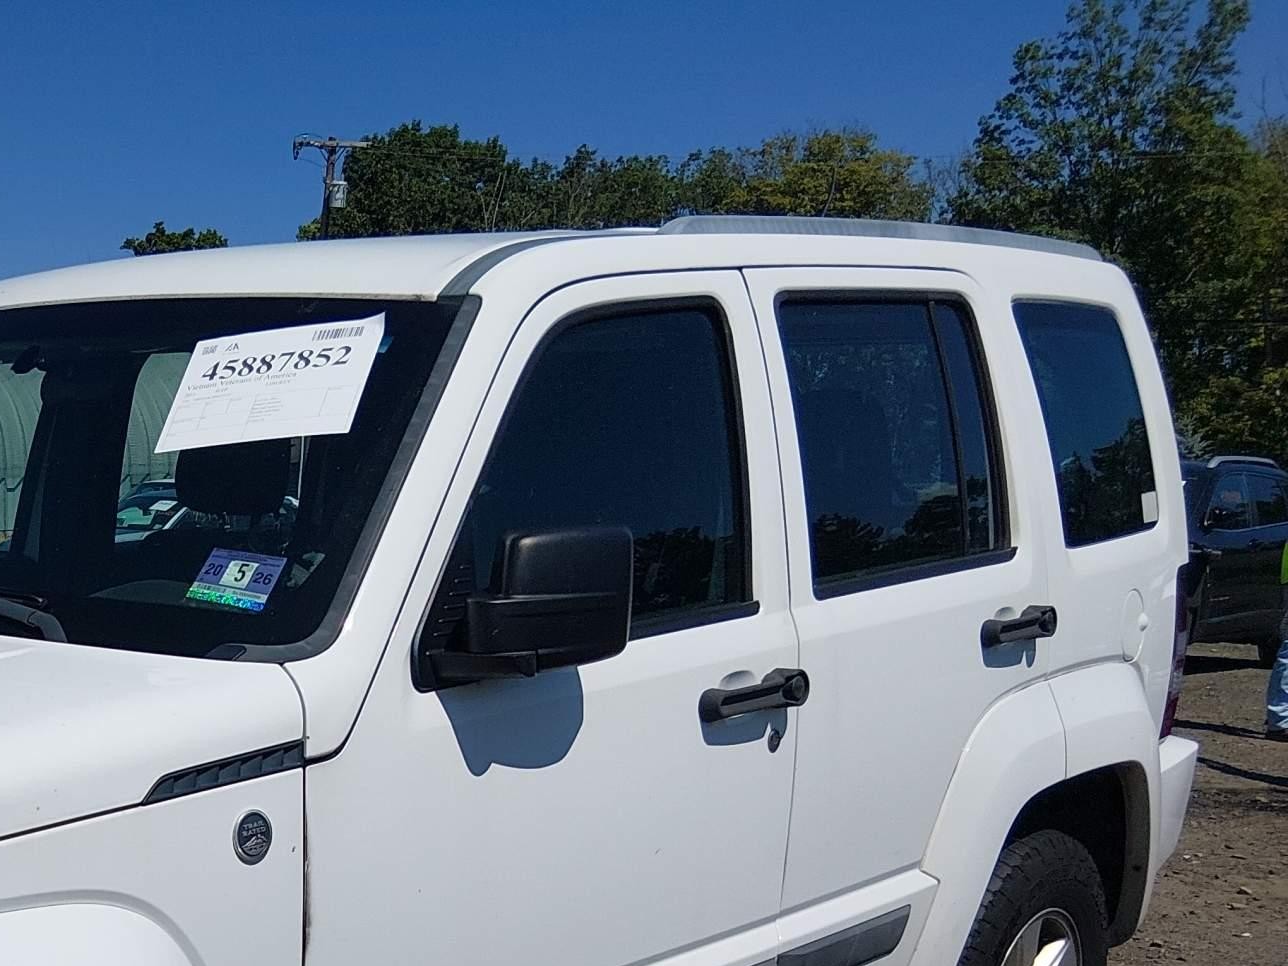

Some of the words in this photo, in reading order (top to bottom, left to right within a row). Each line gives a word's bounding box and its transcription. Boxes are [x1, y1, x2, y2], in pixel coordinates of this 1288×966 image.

[201, 345, 352, 381] 45887852
[204, 563, 225, 577] 20
[234, 563, 250, 582] 5
[253, 572, 274, 586] 26
